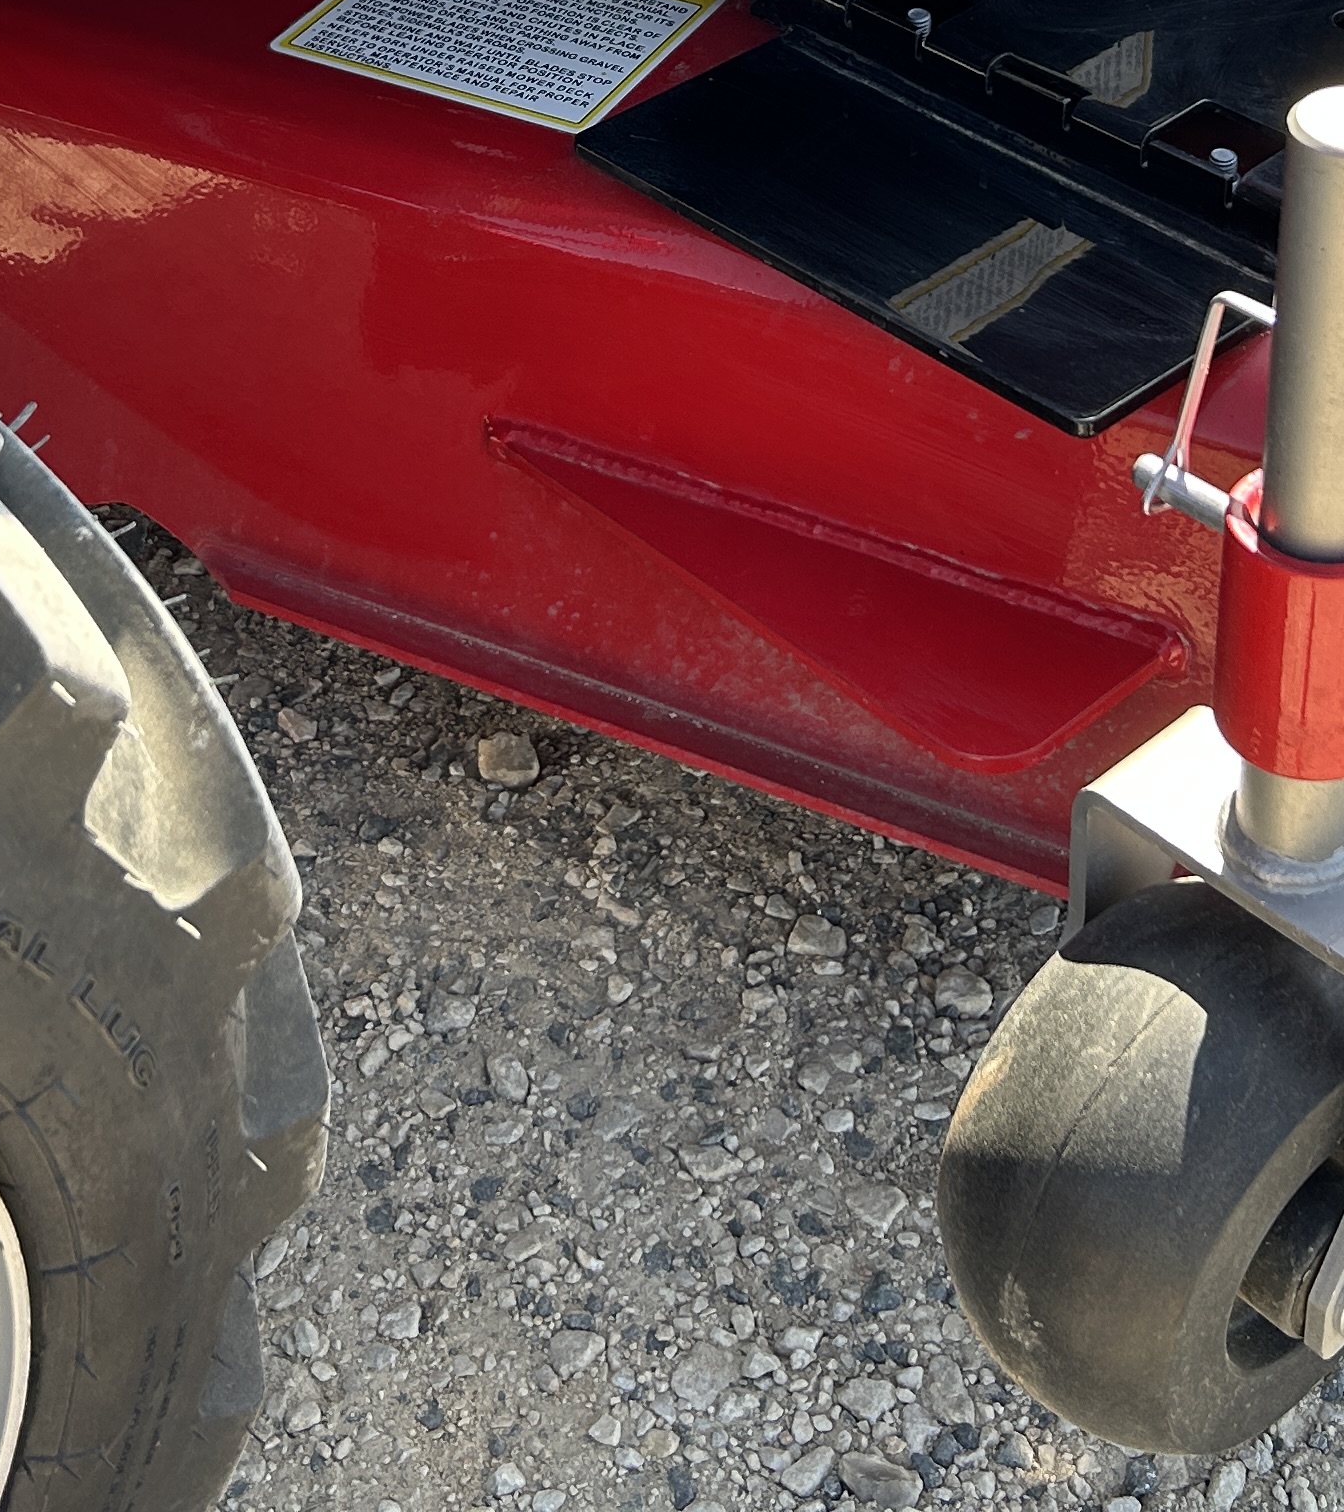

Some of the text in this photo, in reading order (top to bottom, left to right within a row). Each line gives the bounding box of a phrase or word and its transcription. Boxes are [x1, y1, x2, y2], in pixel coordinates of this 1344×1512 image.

[396, 14, 483, 42] SIDEWALKS OR
[436, 9, 457, 18] OR
[455, 14, 516, 34] ROTATING
[496, 8, 528, 20] AND
[526, 16, 583, 35] CHUTES
[582, 31, 600, 39] IN
[501, 1, 530, 12] AND
[528, 8, 583, 26] FOREIGN
[584, 0, 633, 15] MOWER
[632, 11, 654, 21] OR
[652, 17, 676, 27] ITS
[585, 15, 601, 23] IS
[599, 19, 643, 34] CLEAR
[642, 30, 662, 39] OF
[325, 22, 556, 88] NEVER WORK UNDER RAISED MOWER
[334, 15, 518, 68] BEFORE LEAVING OPERATOR
[342, 9, 613, 86] STOP ENGINE AND WAIT UNTIL BLADES STOP
[388, 5, 434, 21] MOWER
[432, 17, 481, 33] BLADES
[478, 29, 516, 43] WHEN
[515, 39, 579, 60] CROSSING
[577, 56, 628, 73] GRAVEL
[481, 13, 510, 24] AND
[507, 20, 570, 41] CLOTHING
[568, 37, 606, 50] AWAY
[604, 46, 642, 60] FROM
[316, 29, 590, 108] REFER TO MANUAL FOR PROPER
[460, 76, 540, 102] AND REPAIR
[68, 976, 156, 1088] LUG
